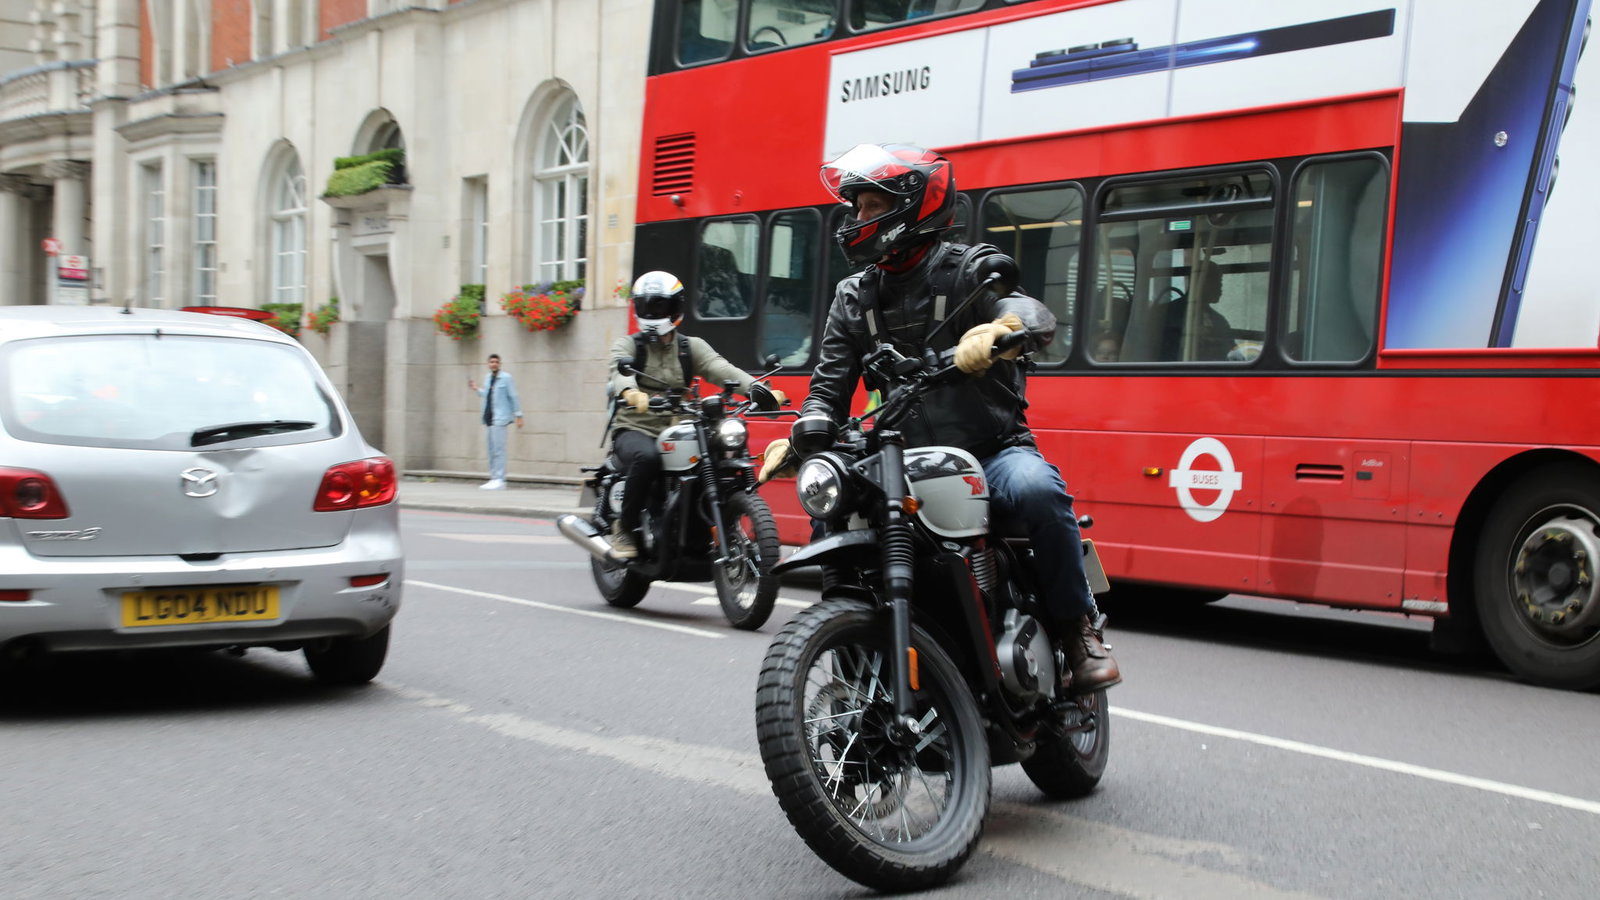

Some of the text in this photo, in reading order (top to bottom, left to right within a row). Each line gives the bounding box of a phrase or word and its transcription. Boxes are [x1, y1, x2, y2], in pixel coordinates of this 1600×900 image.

[842, 66, 930, 103] SAMSUNG
[1192, 473, 1219, 486] BUSES
[135, 590, 268, 621] LG04 NDU
